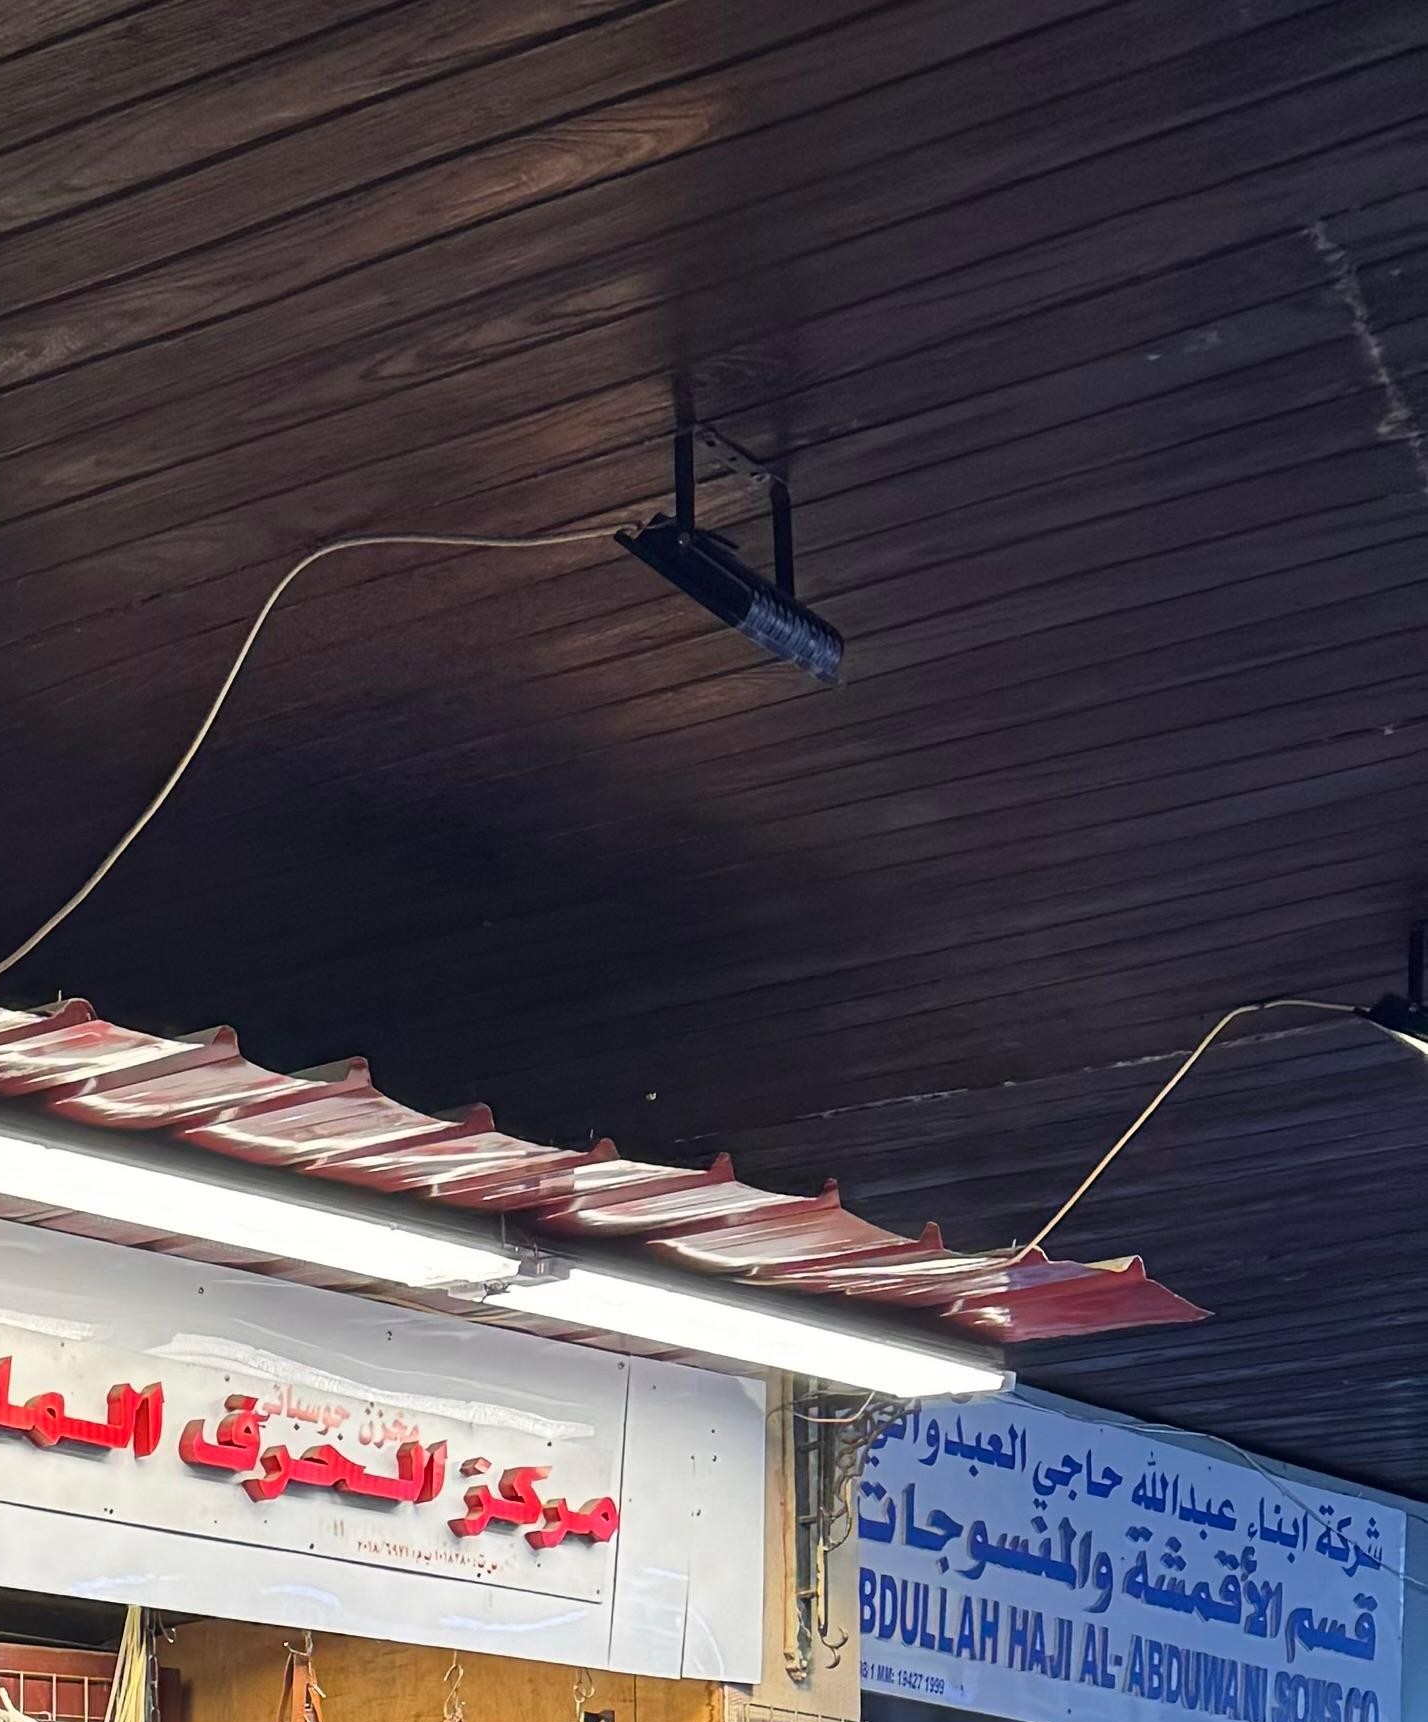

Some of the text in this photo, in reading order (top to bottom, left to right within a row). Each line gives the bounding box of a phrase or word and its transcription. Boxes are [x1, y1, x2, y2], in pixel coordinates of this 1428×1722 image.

[447, 1456, 618, 1550] مركز
[1033, 1449, 1123, 1511] حاجي
[1316, 1504, 1383, 1577] شركة
[1122, 1526, 1283, 1639] الأقمشة
[1007, 1604, 1073, 1681] HAJI
[1285, 1593, 1378, 1665] قسم
